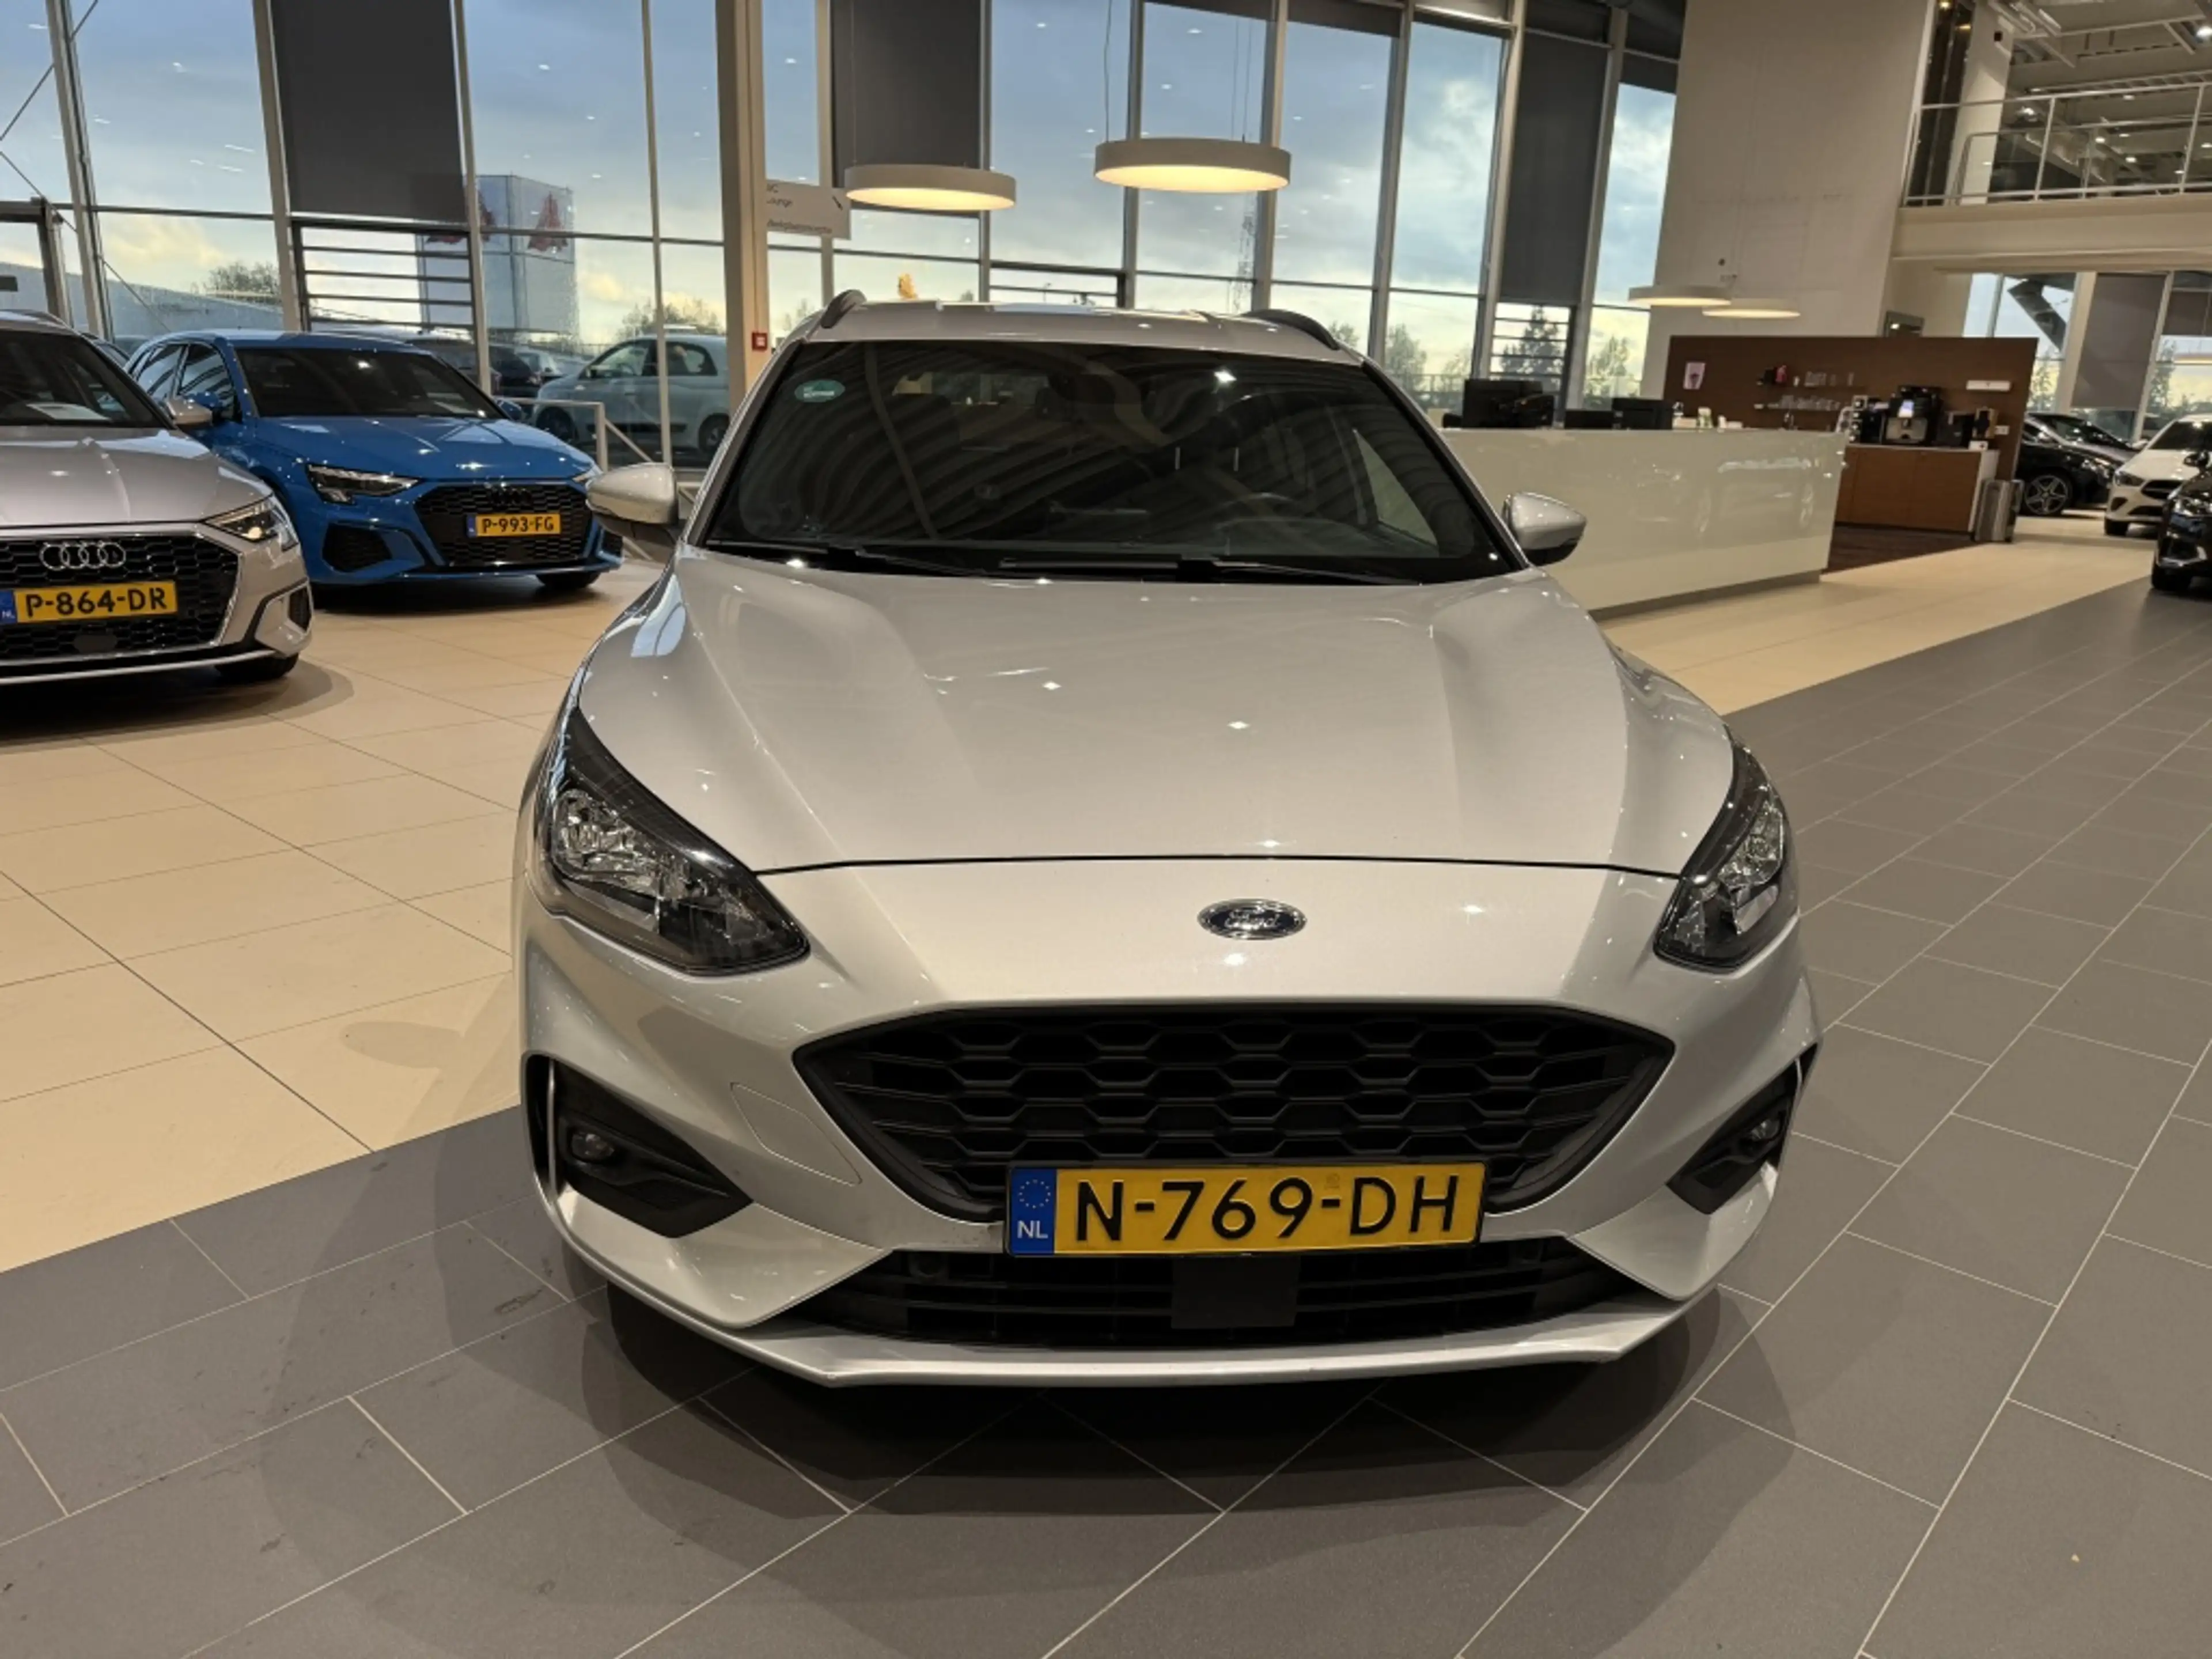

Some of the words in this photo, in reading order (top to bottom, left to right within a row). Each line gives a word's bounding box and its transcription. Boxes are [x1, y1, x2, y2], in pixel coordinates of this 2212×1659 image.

[482, 516, 554, 533] P-993-FG
[25, 588, 167, 618] P-864-DR
[1076, 1175, 1459, 1241] N-769-DH
[1017, 1220, 1048, 1239] NL
